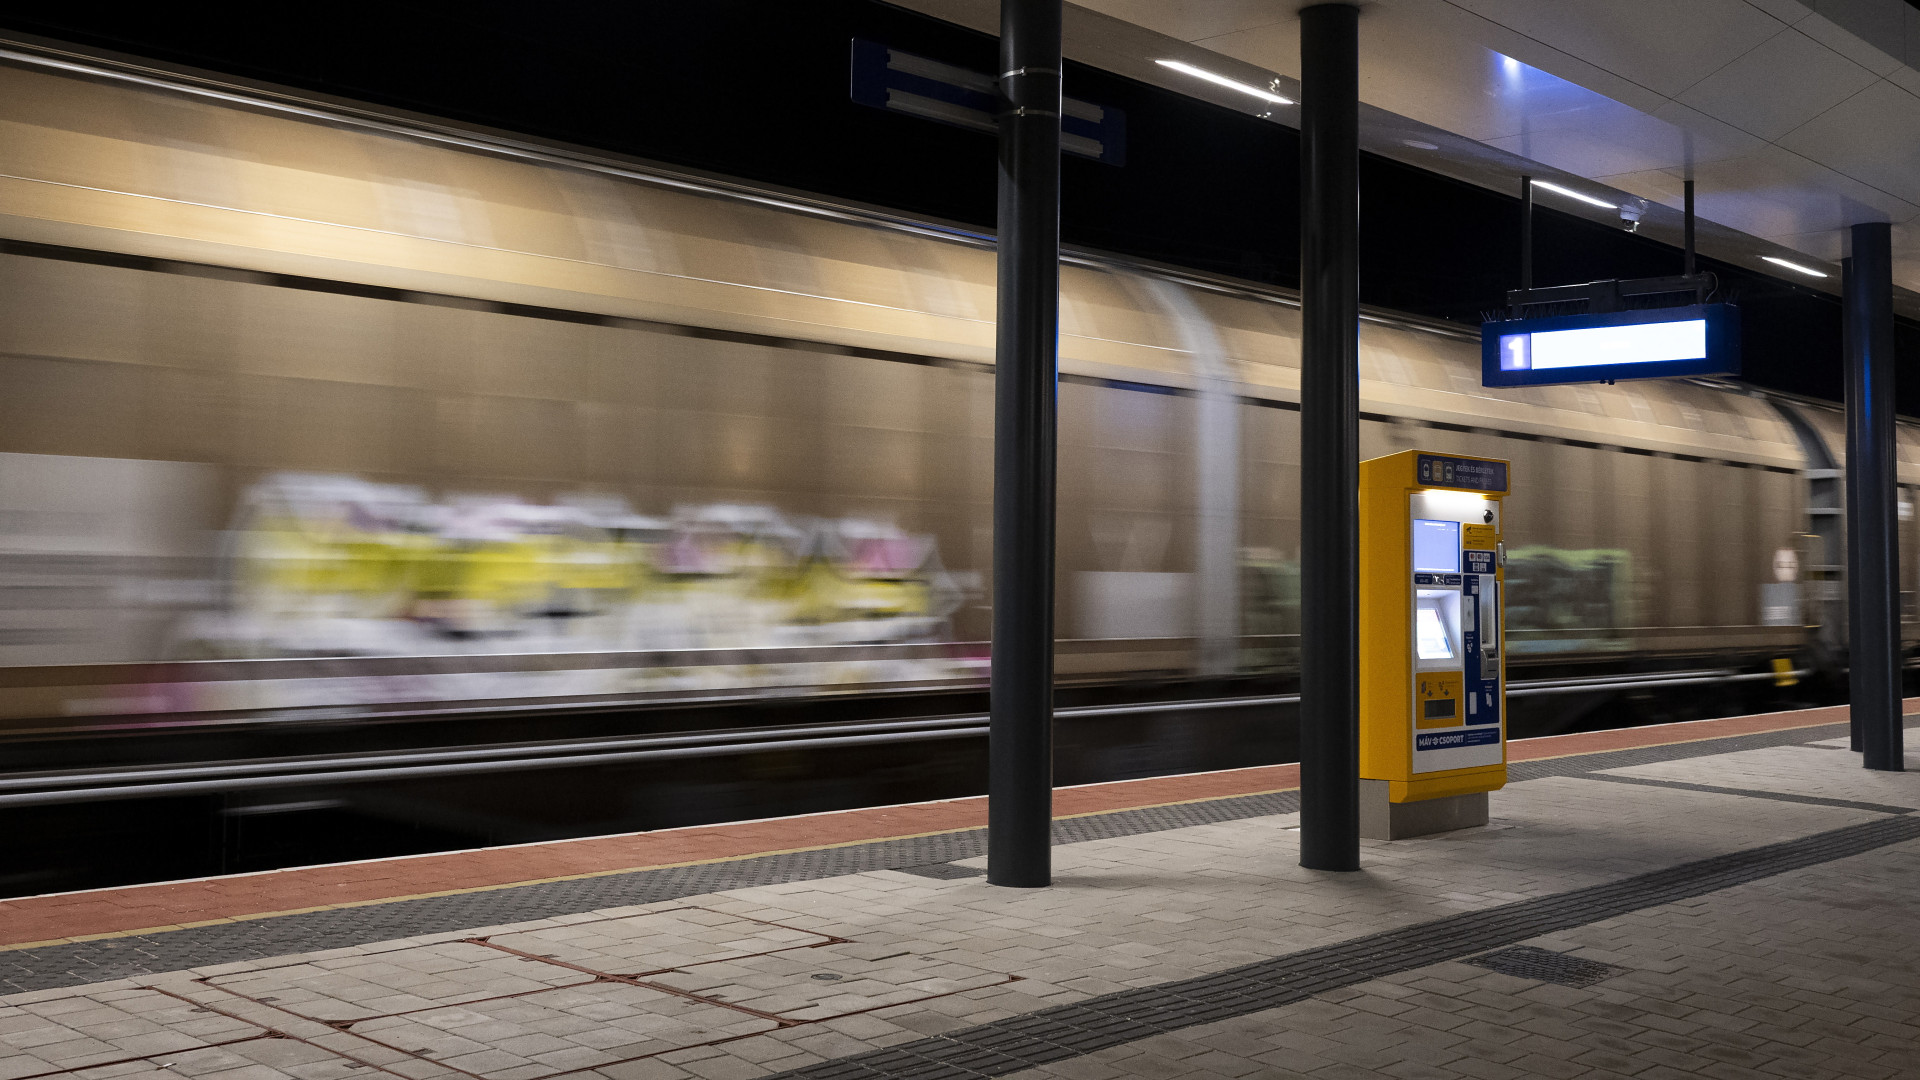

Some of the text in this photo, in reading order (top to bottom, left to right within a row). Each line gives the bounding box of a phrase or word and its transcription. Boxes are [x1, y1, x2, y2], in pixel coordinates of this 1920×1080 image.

[1508, 337, 1523, 367] 1
[1419, 736, 1432, 746] MÁV
[1439, 735, 1464, 744] CSOPORT
